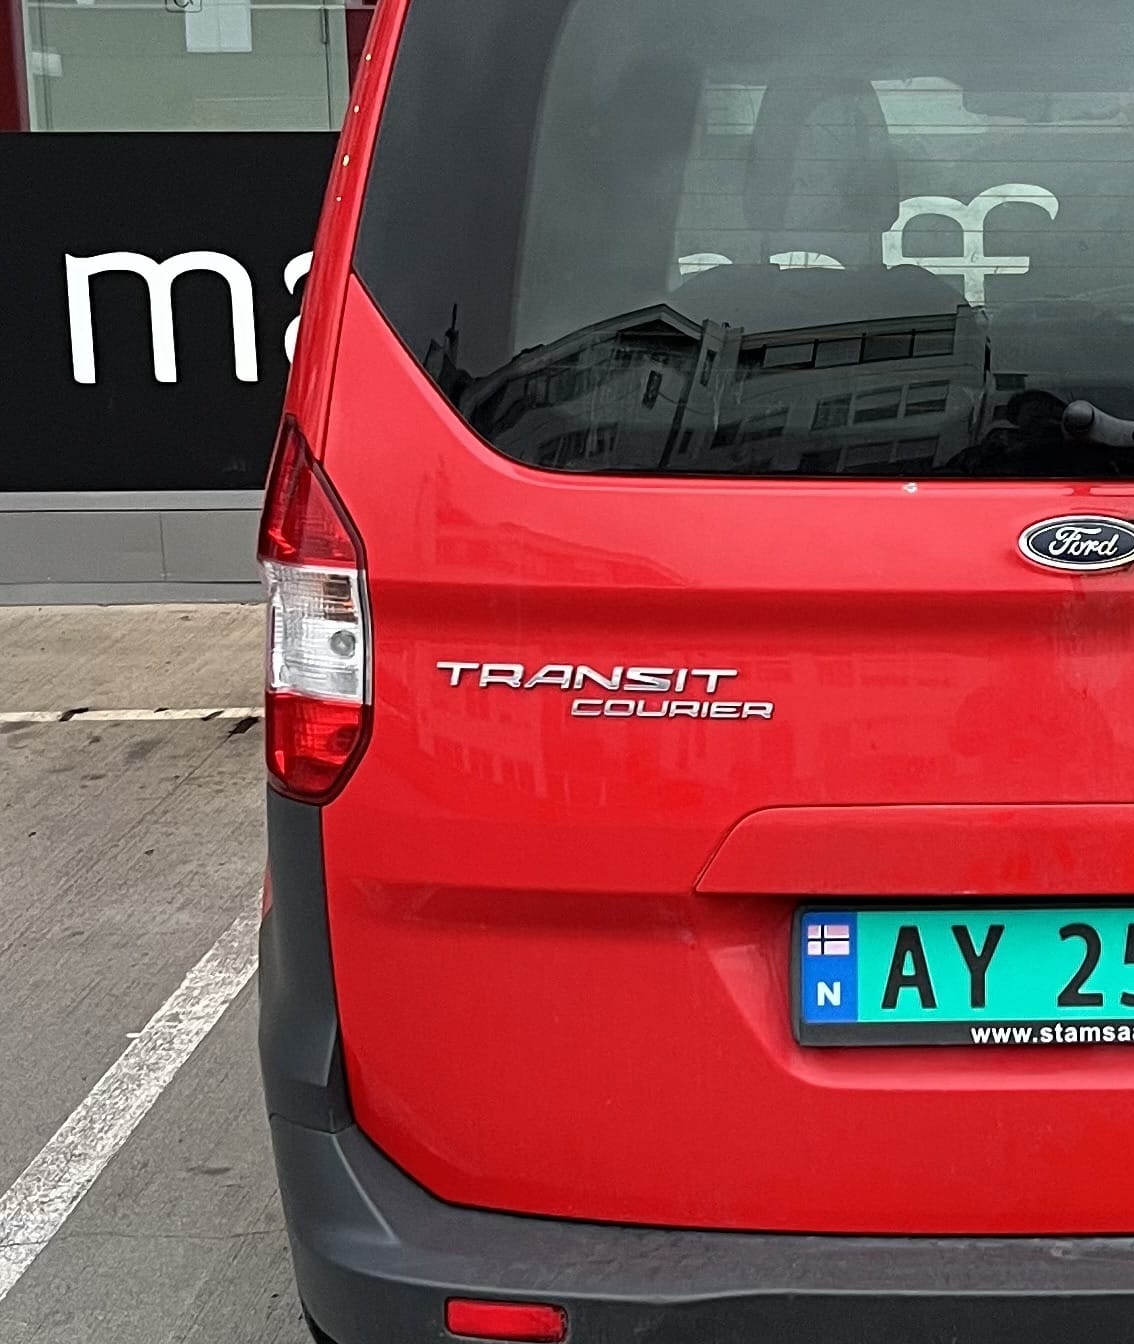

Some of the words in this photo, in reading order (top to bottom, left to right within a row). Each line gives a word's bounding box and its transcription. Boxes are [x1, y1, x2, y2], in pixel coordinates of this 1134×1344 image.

[1048, 526, 1120, 556] Ford
[436, 661, 738, 693] TRANSIT
[571, 698, 774, 719] COURIER
[881, 924, 1005, 1009] AY
[817, 982, 841, 1006] N
